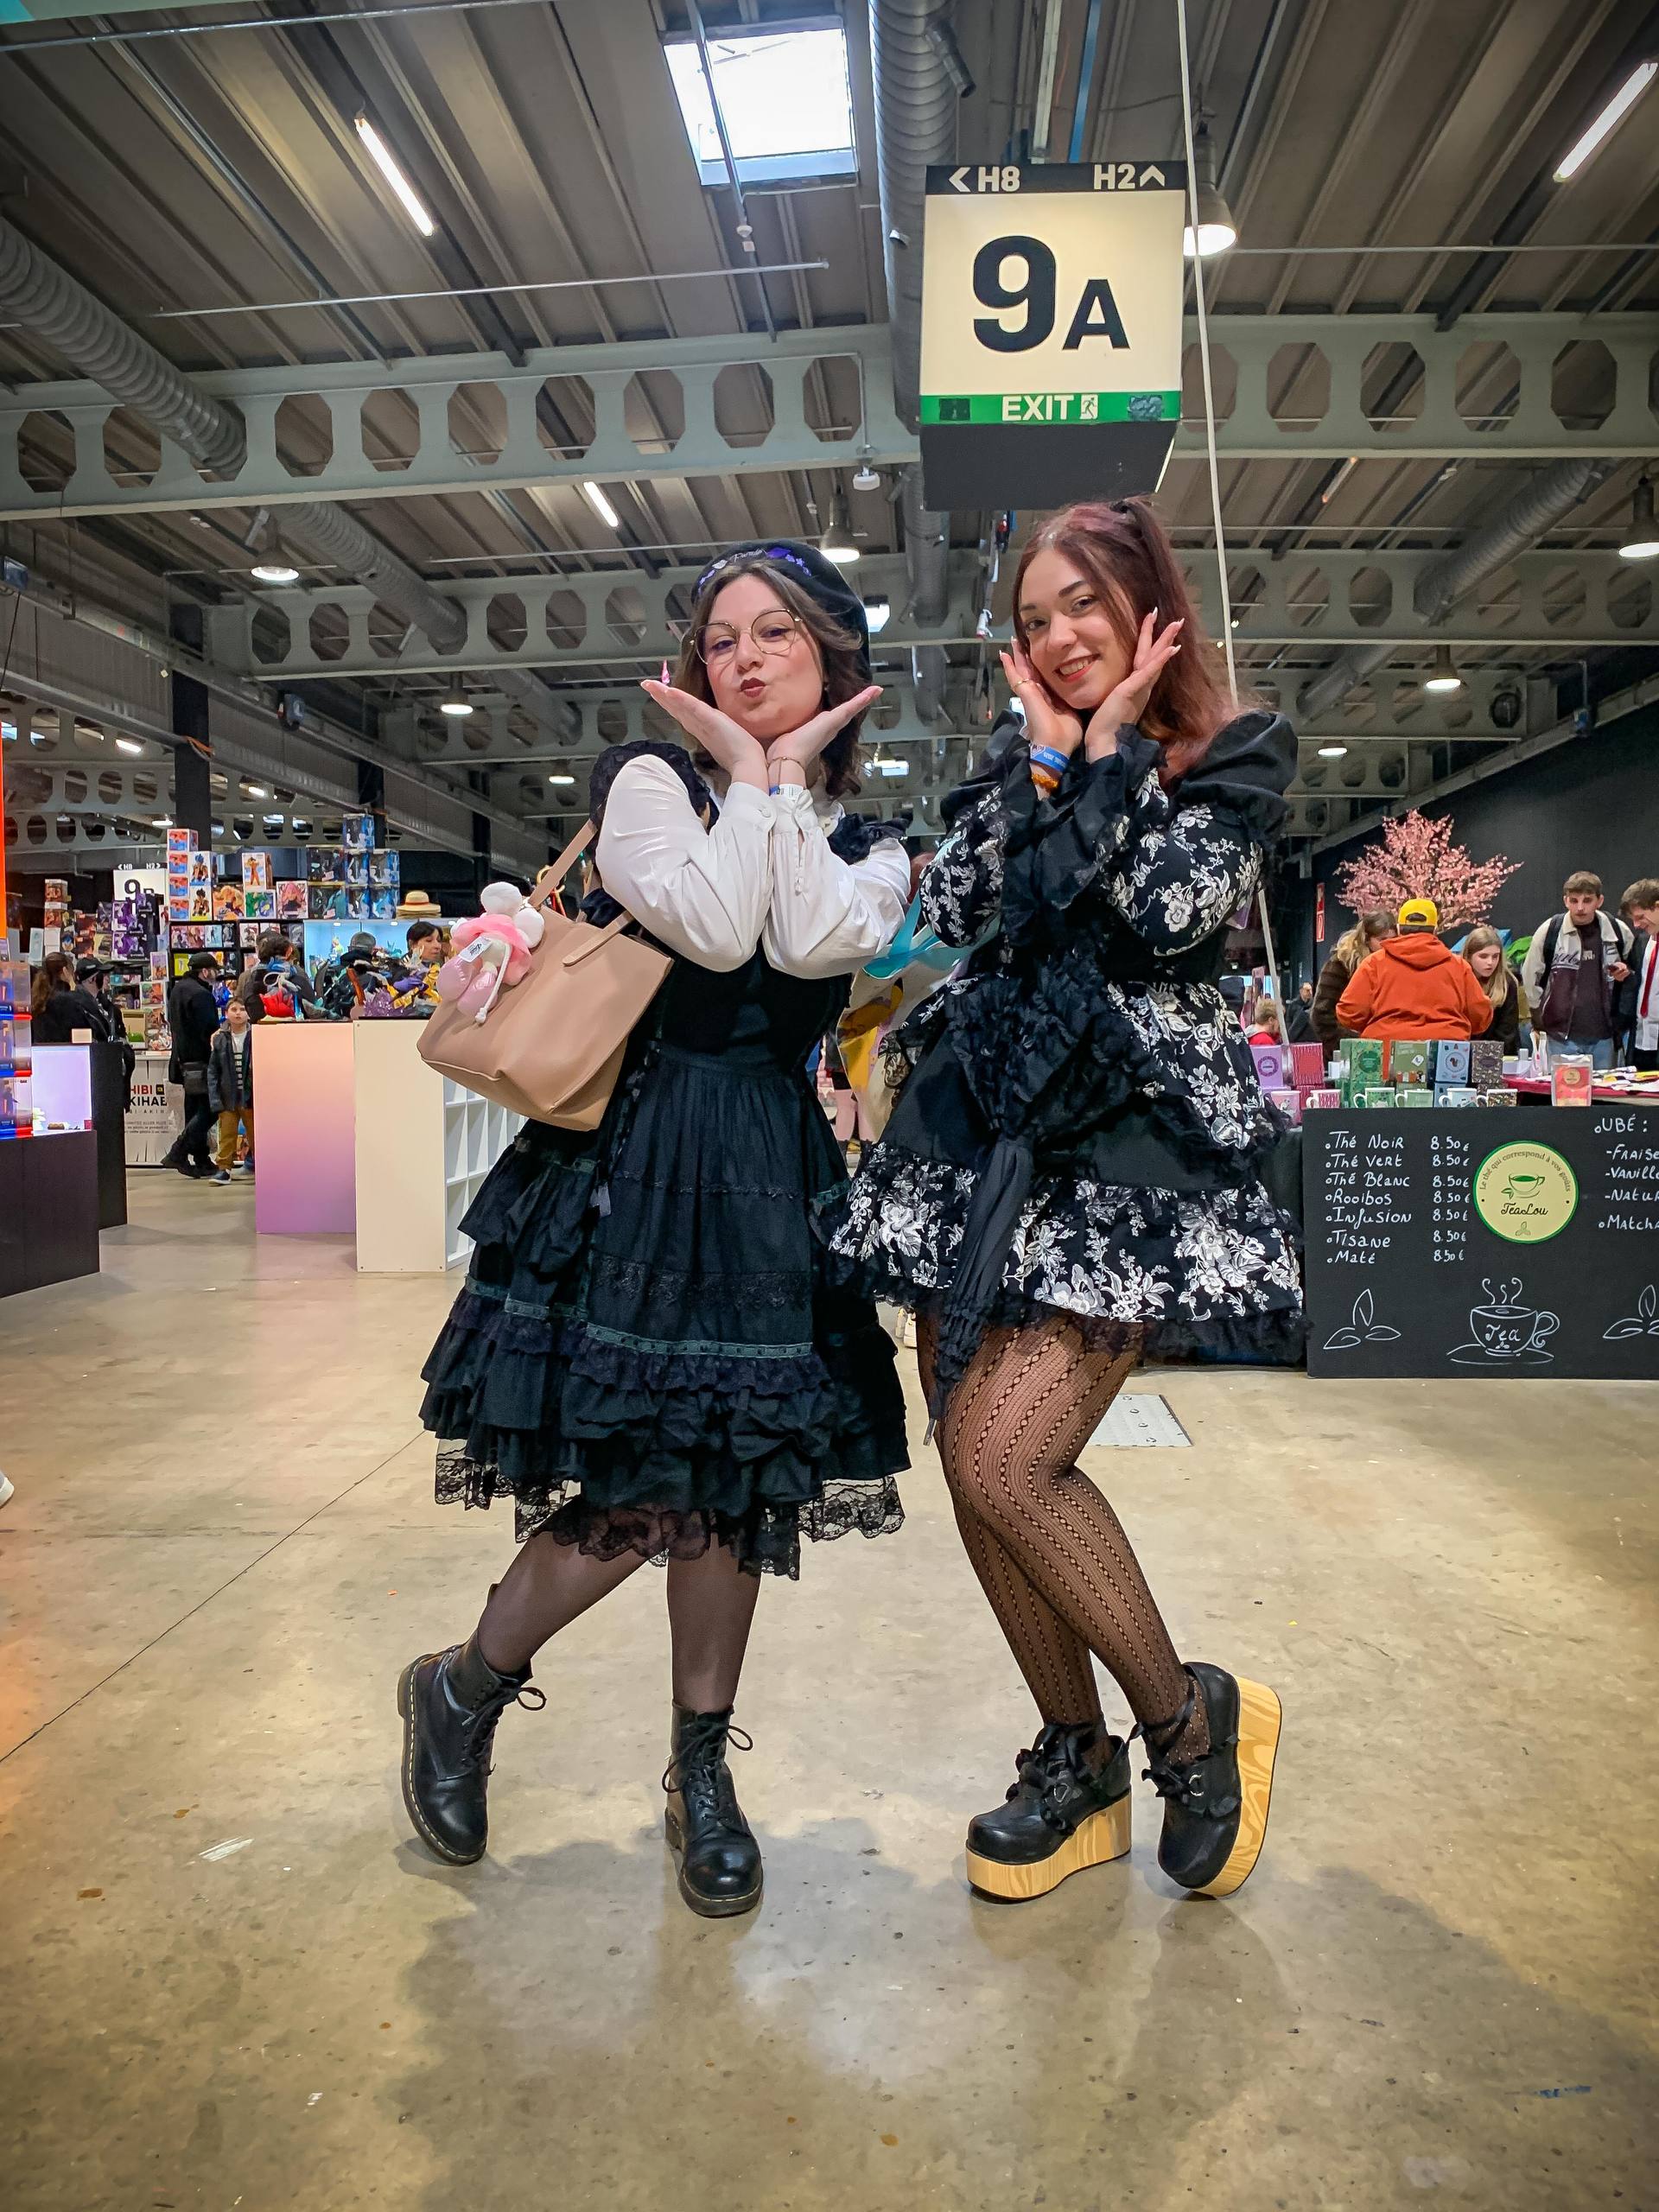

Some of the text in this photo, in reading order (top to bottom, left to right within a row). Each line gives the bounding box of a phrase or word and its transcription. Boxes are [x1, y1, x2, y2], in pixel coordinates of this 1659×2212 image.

[978, 165, 1020, 193] H8
[1094, 163, 1135, 190] H2
[1001, 394, 1075, 422] EXIT
[1329, 1131, 1357, 1149] Thé
[1331, 1154, 1358, 1168] Thé
[1329, 1172, 1356, 1185] Thé
[1479, 1182, 1487, 1190] Le
[1483, 1168, 1493, 1181] thé
[1491, 1158, 1502, 1170] qui
[1502, 1151, 1546, 1161] correspond
[1551, 1160, 1562, 1172] vos
[1333, 1188, 1392, 1206] Rooibos
[1500, 1202, 1549, 1216] TeaLou
[1335, 1250, 1376, 1264] Maté
[1485, 1324, 1521, 1341] Tea
